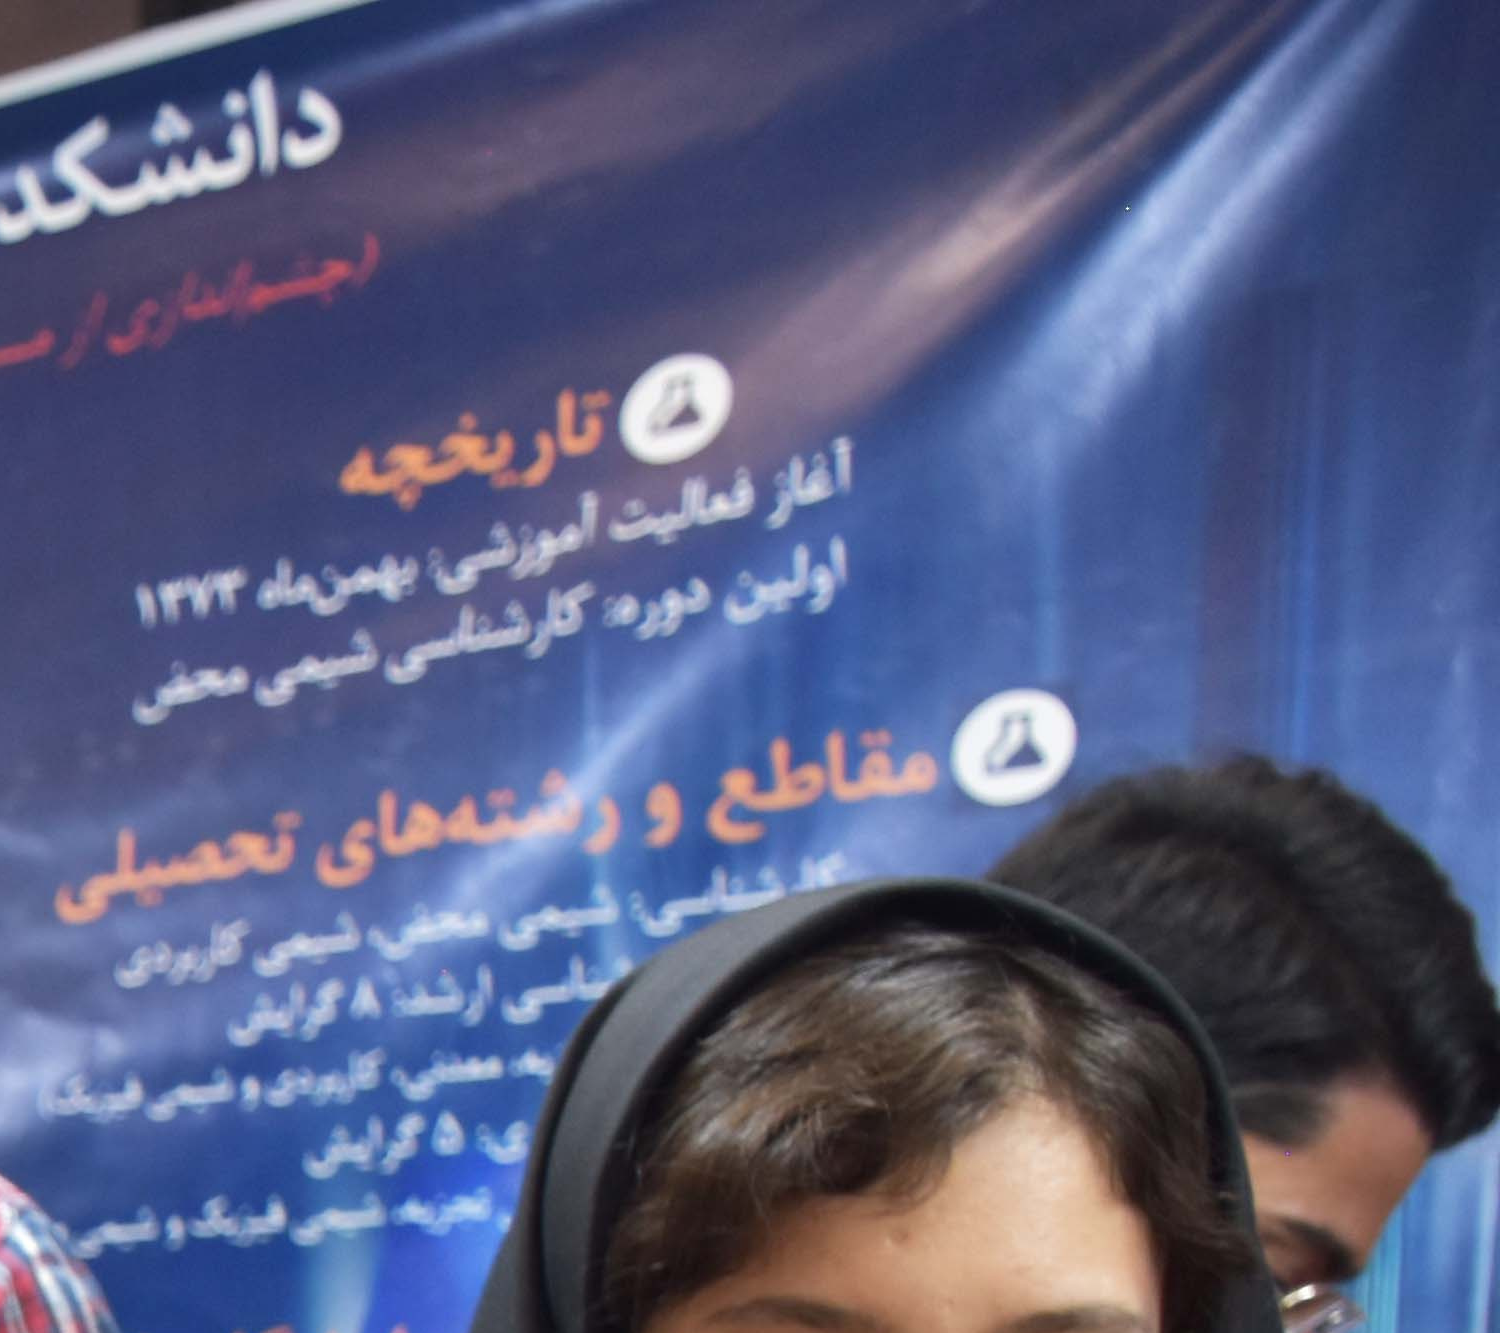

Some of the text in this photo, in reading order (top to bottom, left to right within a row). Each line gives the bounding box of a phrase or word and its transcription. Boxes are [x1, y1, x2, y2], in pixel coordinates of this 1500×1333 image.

[340, 388, 611, 510] تاریخچه
[608, 467, 756, 544] فعالیت
[254, 627, 380, 707] شیمی
[384, 581, 597, 684] کارشناسی
[131, 660, 250, 728] محض
[644, 781, 683, 848] و
[706, 729, 939, 844] مقاطع
[54, 810, 304, 925] تحصیلی
